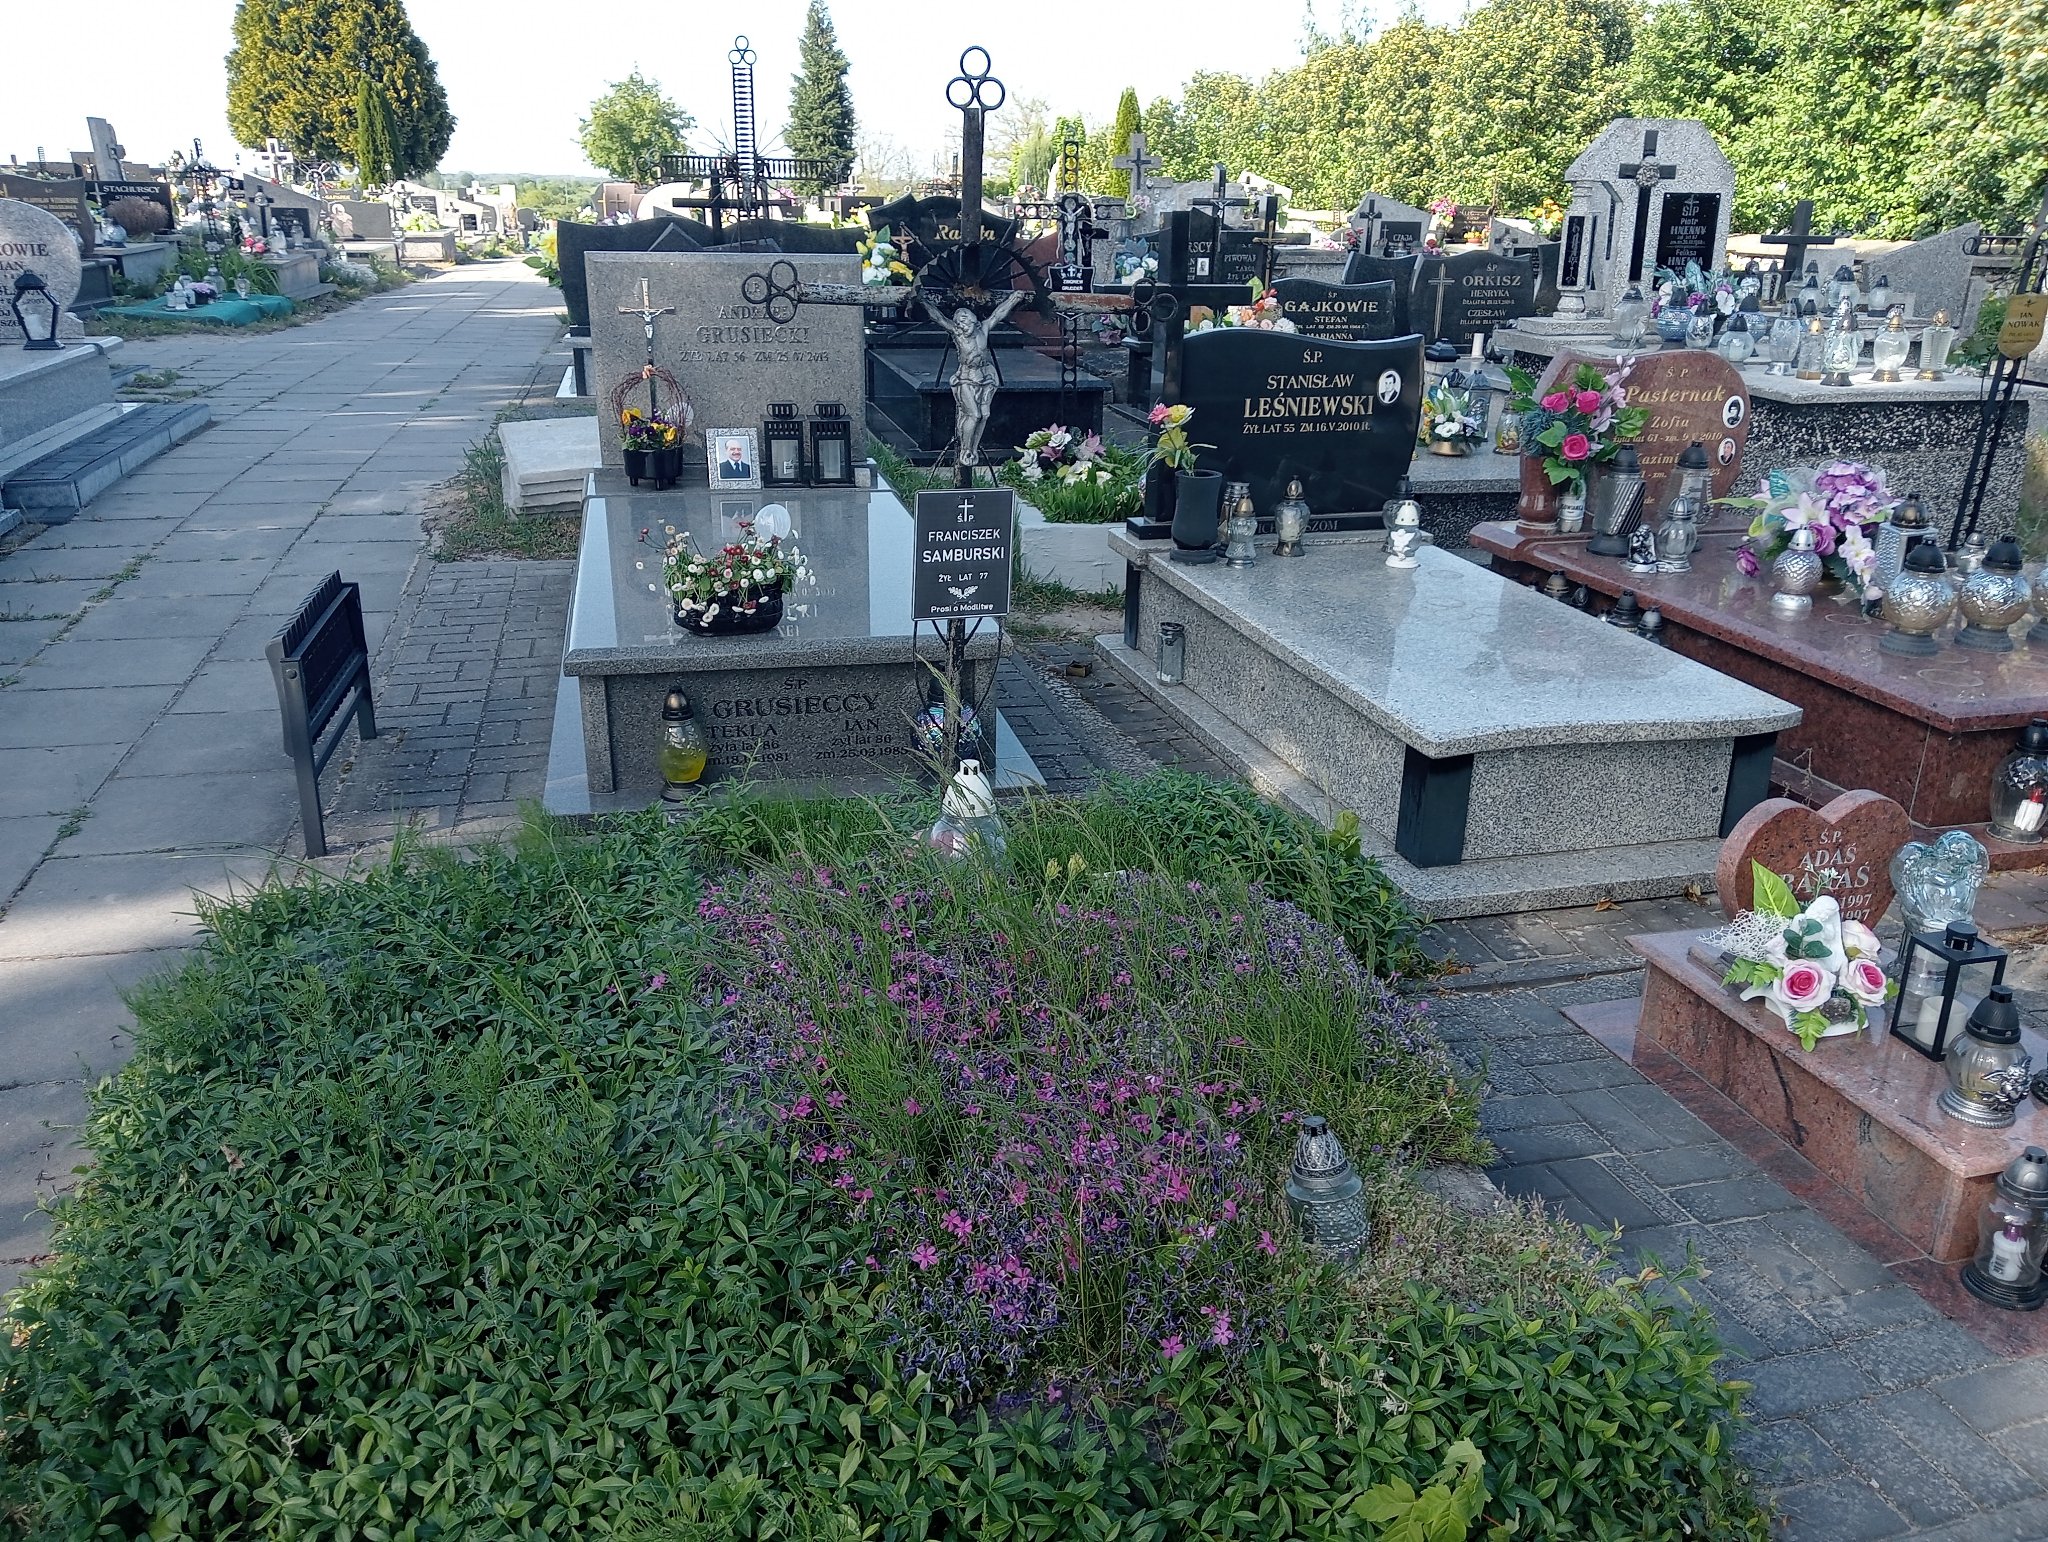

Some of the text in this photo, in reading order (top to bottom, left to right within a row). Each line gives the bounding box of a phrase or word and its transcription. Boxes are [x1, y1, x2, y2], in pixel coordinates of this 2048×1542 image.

[103, 185, 161, 194] STACHURSCY
[1462, 275, 1521, 286] ORKISZ
[1470, 289, 1510, 297] HENRYKA
[1284, 300, 1379, 312] GAJKOWIE
[1314, 315, 1348, 323] STEFAN
[1467, 309, 1507, 317] CZESŁAW
[696, 325, 811, 344] GRUSIECKI
[1267, 374, 1354, 389] STANISŁAW
[1624, 384, 1726, 403] Pasternak
[1243, 392, 1375, 418] LEŚNIEWSKI
[1243, 422, 1261, 434] ŻYŁ
[1262, 423, 1282, 433] LAT
[1283, 423, 1295, 433] 55
[1651, 416, 1690, 430] Zofia
[1700, 432, 1723, 441] 2010
[928, 528, 1001, 542] FRANCISZEK
[922, 546, 1005, 563] SAMBURSKI
[938, 572, 988, 582] ŻYŁ LAT 77
[931, 604, 952, 613] Prosi
[960, 602, 994, 612] Modlitwę
[712, 693, 881, 719] GRUSIECCY
[708, 723, 779, 739] TEKLA
[841, 718, 881, 733] JAN
[876, 734, 892, 744] 86
[1798, 842, 1857, 868] ADAŚ
